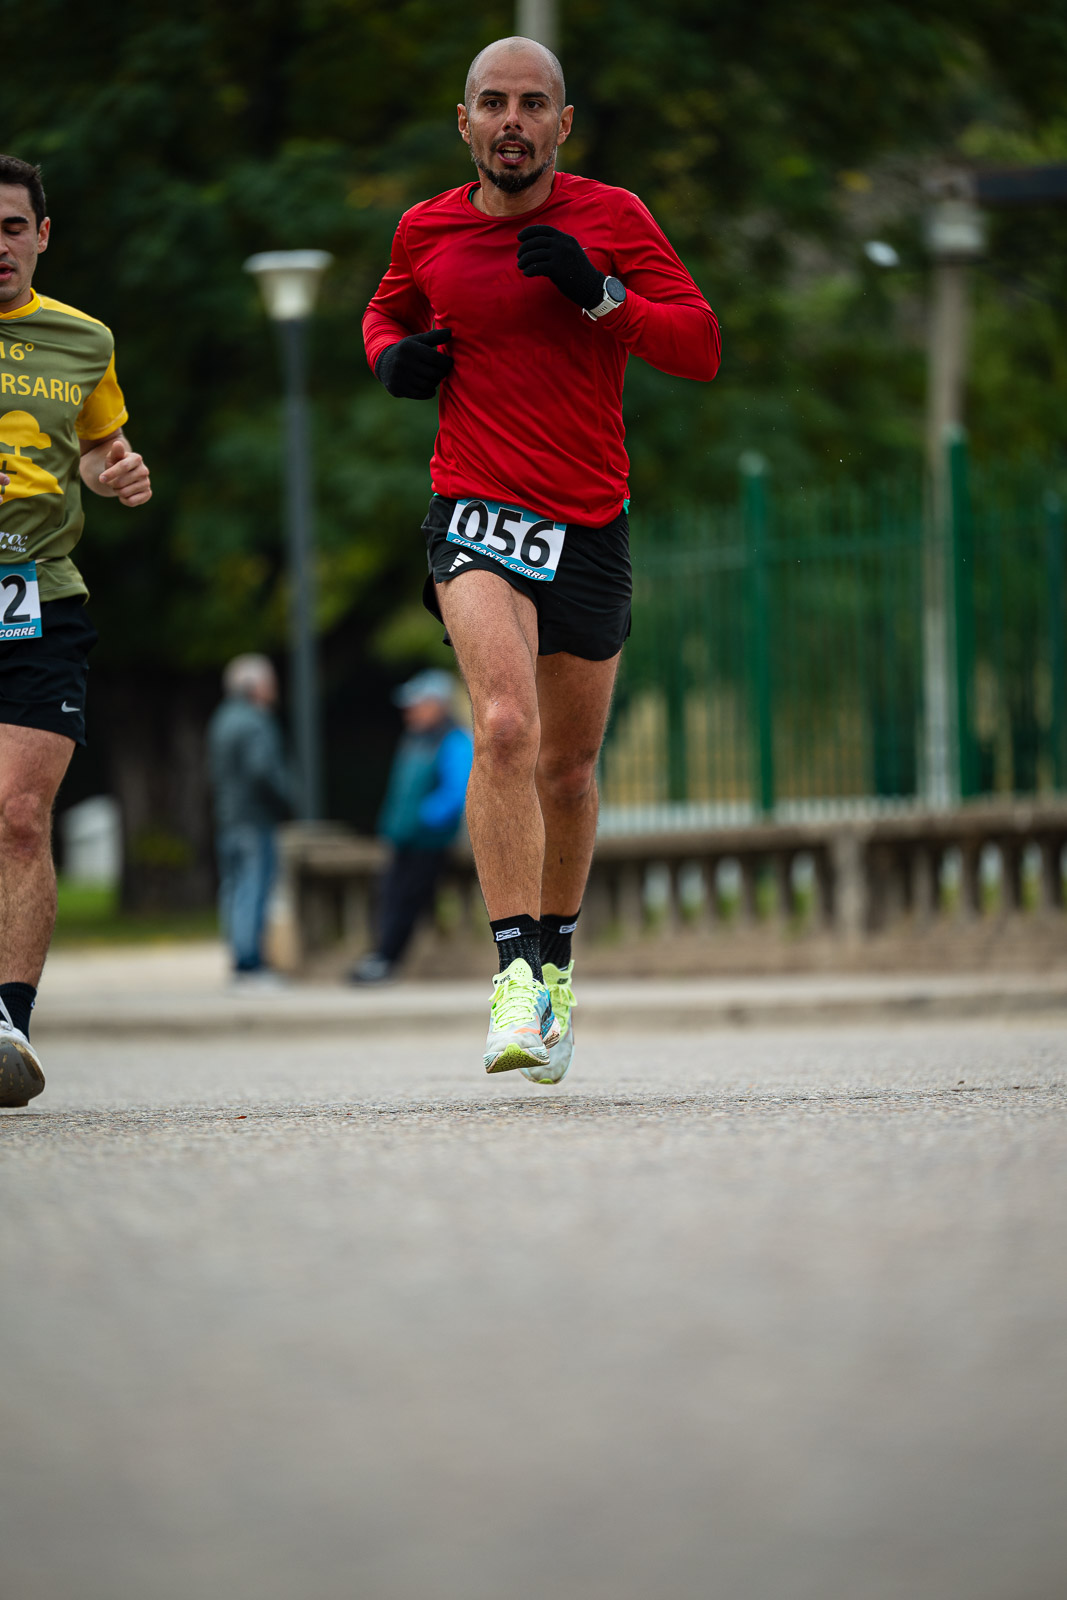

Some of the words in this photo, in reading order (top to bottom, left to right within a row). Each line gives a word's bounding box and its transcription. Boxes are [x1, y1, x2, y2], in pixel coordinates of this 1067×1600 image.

[0, 372, 82, 406] RSARIO
[456, 499, 555, 569] 056
[452, 538, 509, 565] DIAMANTE
[509, 563, 549, 580] CORRE
[0, 574, 32, 625] 2
[0, 626, 36, 639] CORRE
